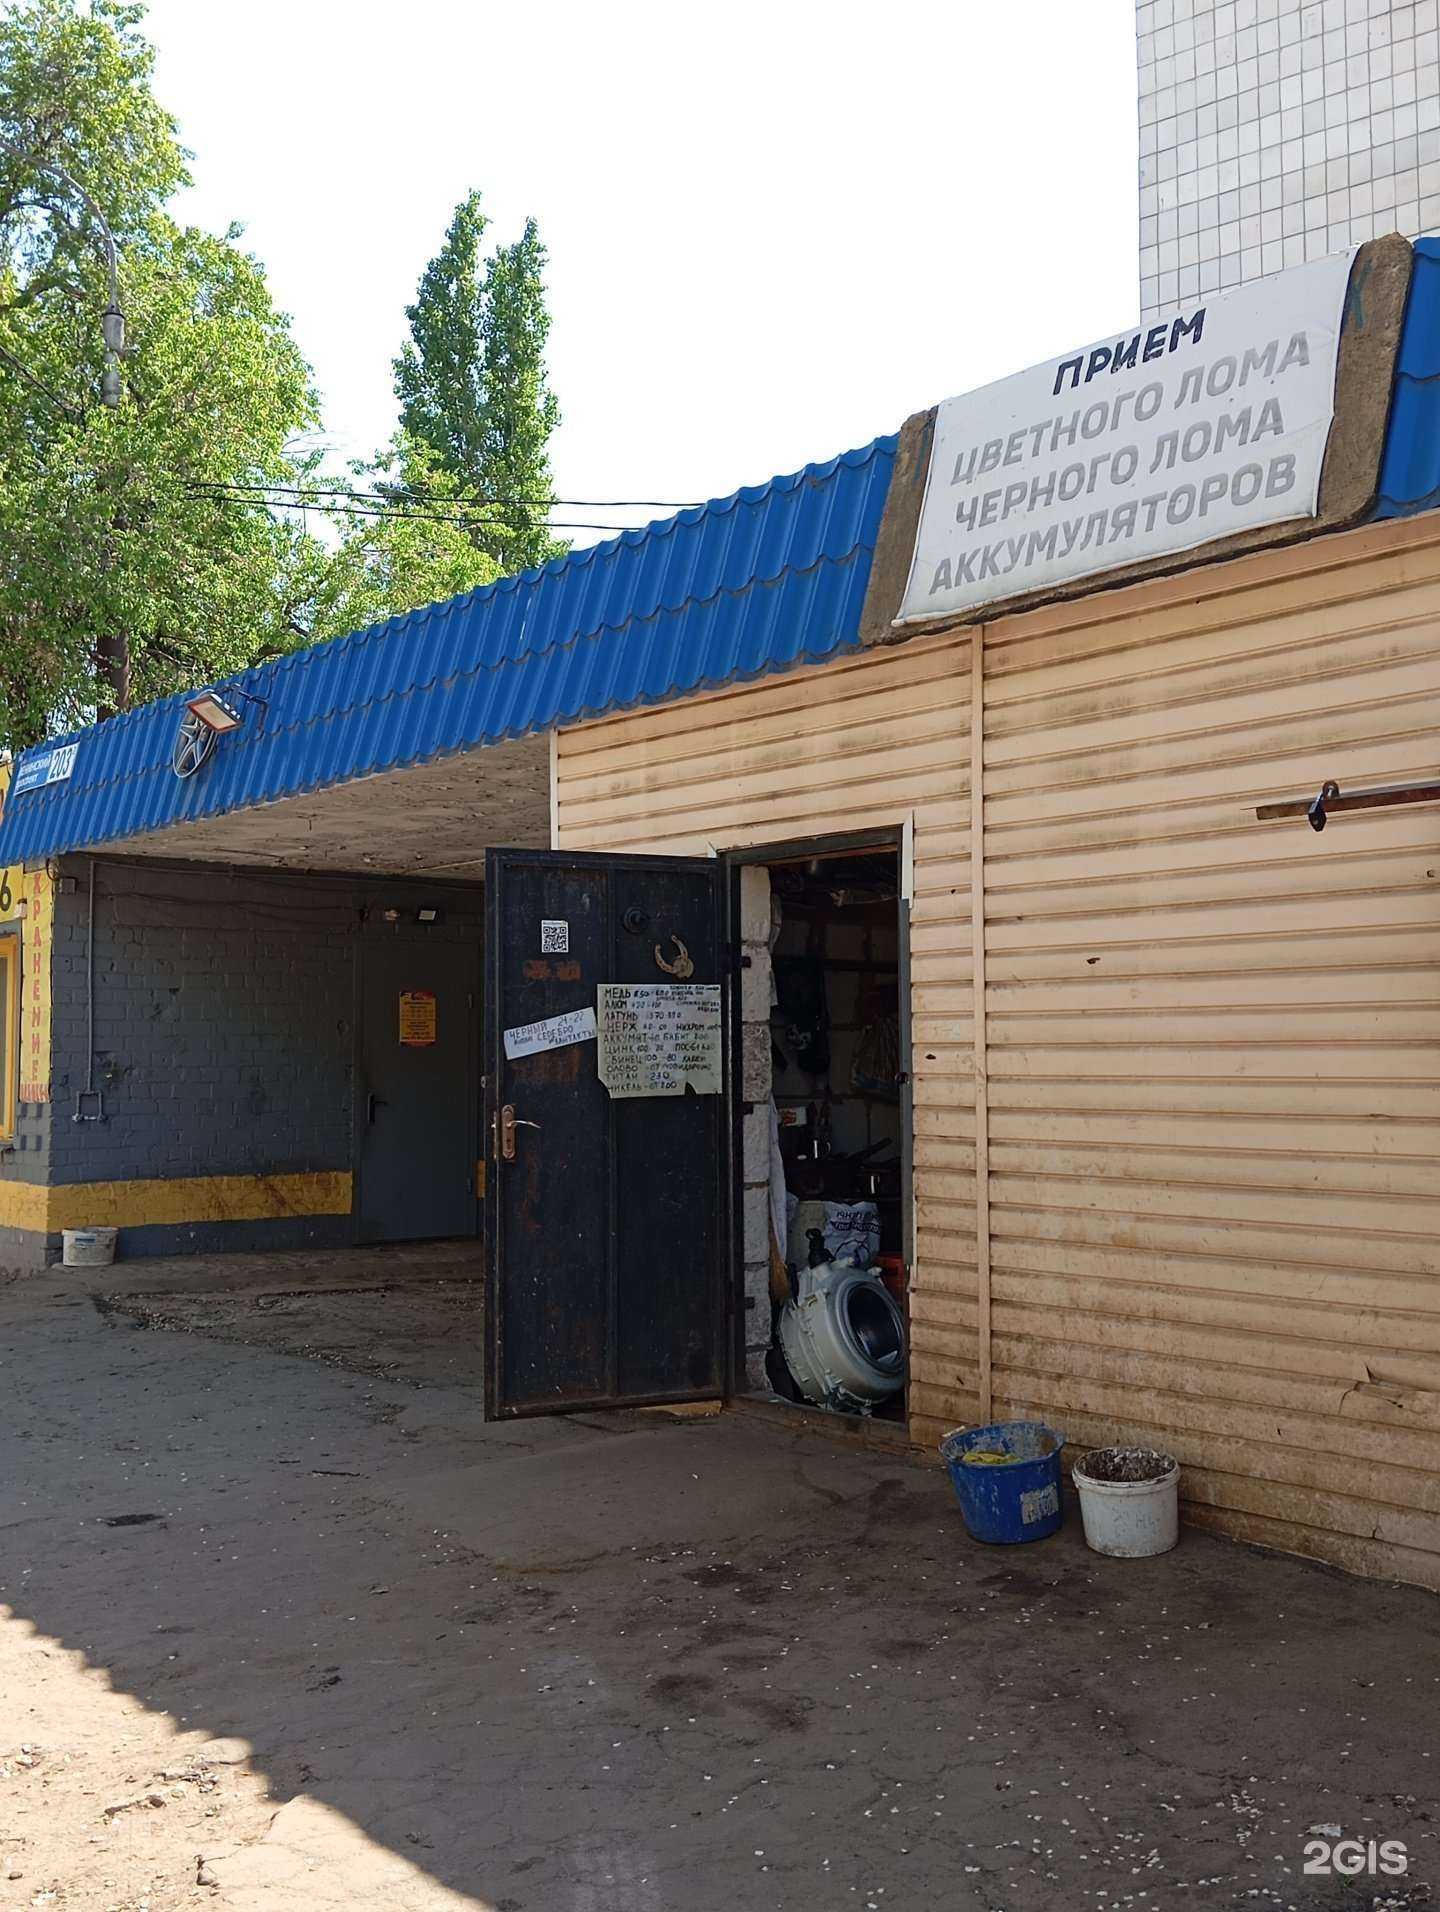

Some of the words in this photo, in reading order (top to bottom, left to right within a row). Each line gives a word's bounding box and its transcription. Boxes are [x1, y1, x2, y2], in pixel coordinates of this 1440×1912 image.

[1053, 308, 1206, 396] ПРИЕМ
[951, 381, 1161, 487] ЦВЕТНОГО
[1174, 330, 1311, 411] ЛОМА
[955, 444, 1139, 533] ЧЕРНОГО
[1149, 397, 1284, 475] ЛОМА
[928, 454, 1296, 595] АККУМУЛЯТОРОВ
[50, 748, 73, 780] 203
[604, 987, 631, 999] МЕДЬ
